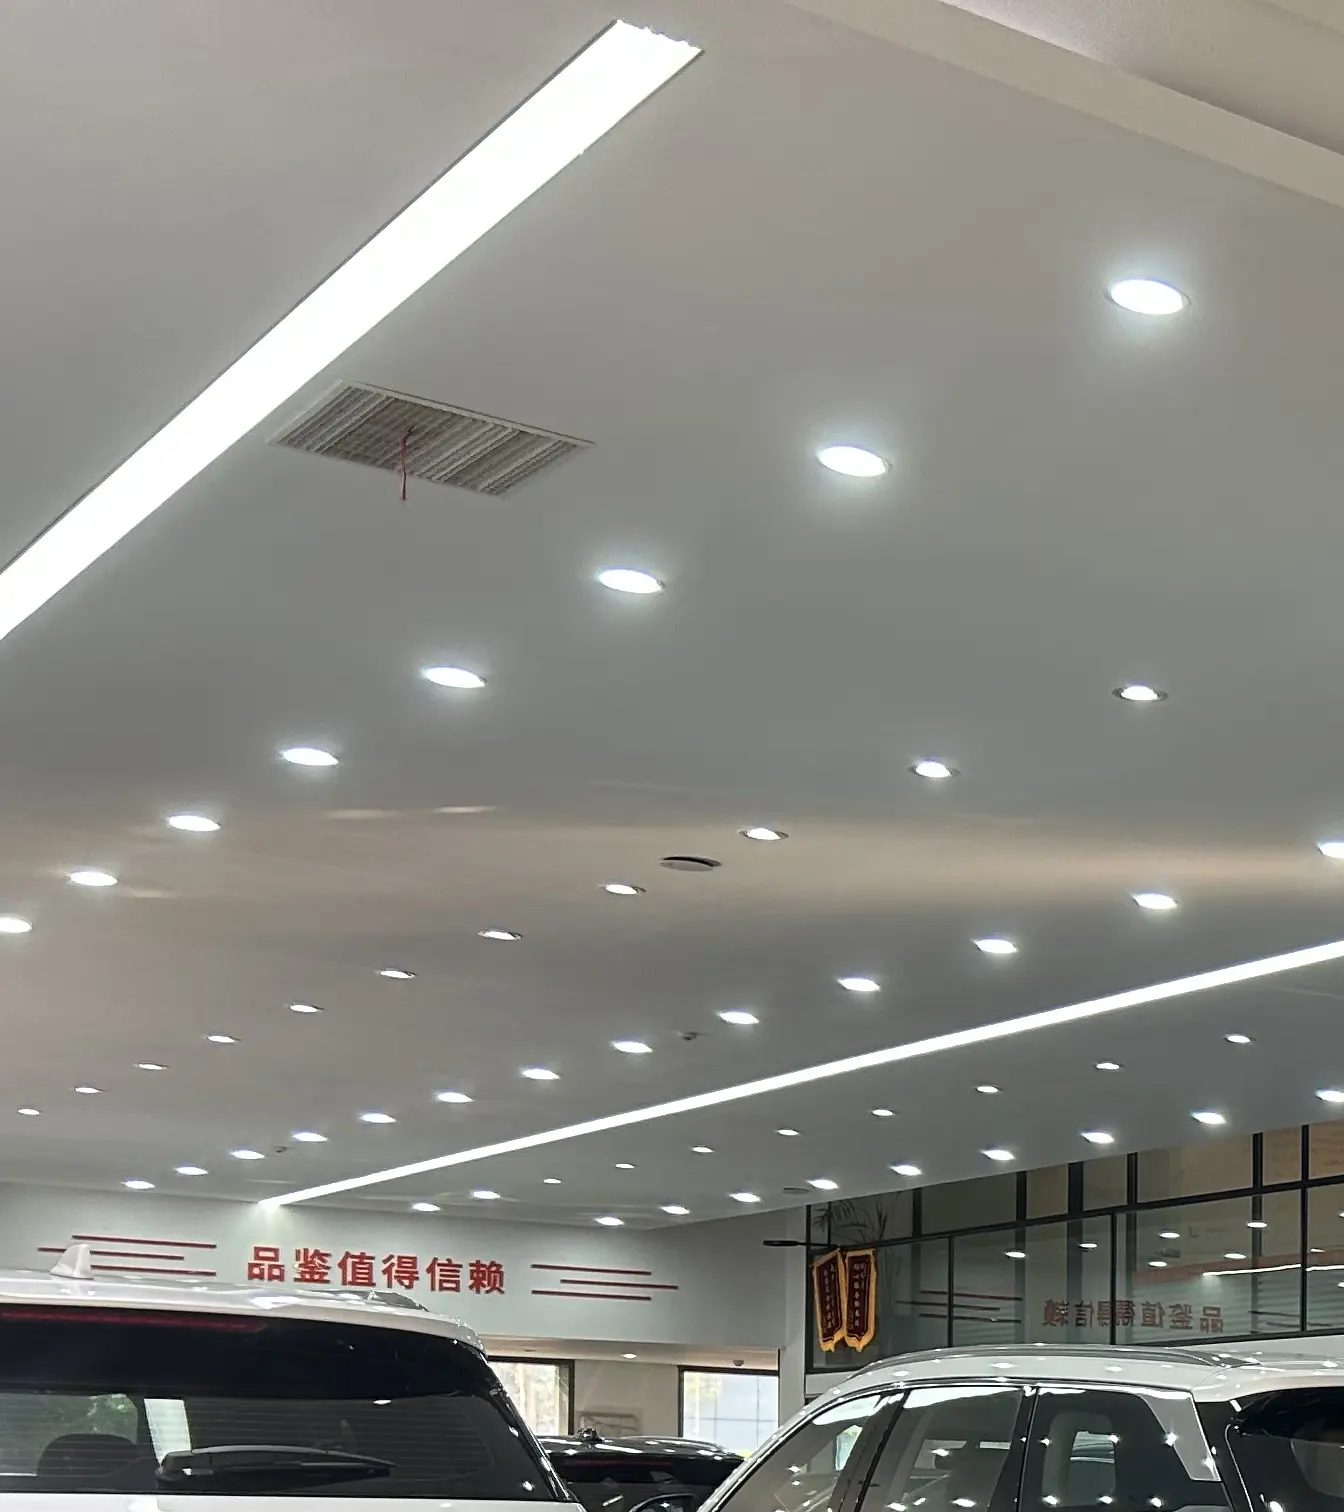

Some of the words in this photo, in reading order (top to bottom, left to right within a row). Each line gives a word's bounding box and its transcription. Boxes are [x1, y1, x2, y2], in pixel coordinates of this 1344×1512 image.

[247, 1246, 506, 1295] 品鉴值得信赖
